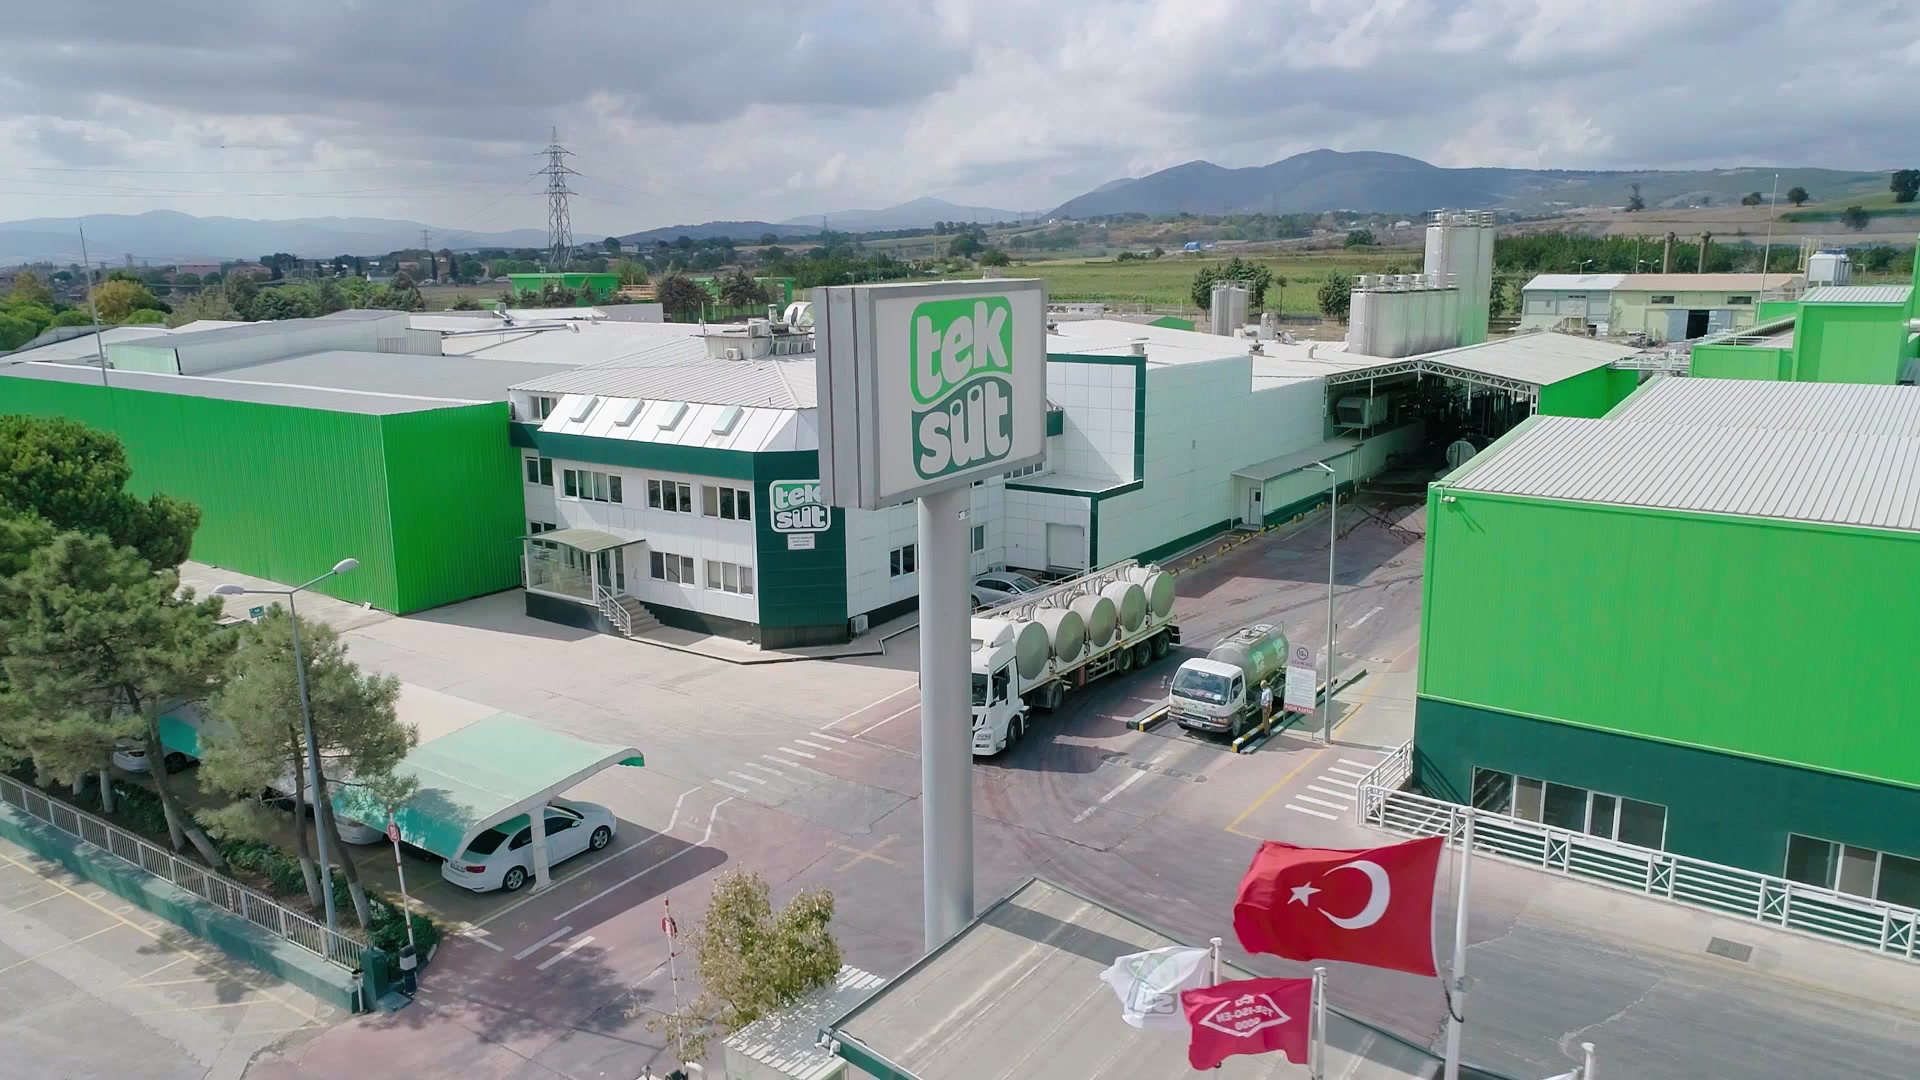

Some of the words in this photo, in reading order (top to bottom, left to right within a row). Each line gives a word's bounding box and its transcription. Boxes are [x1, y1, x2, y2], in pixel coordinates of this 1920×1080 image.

[916, 301, 1008, 399] tek
[919, 381, 1010, 474] süt
[775, 484, 821, 509] tek
